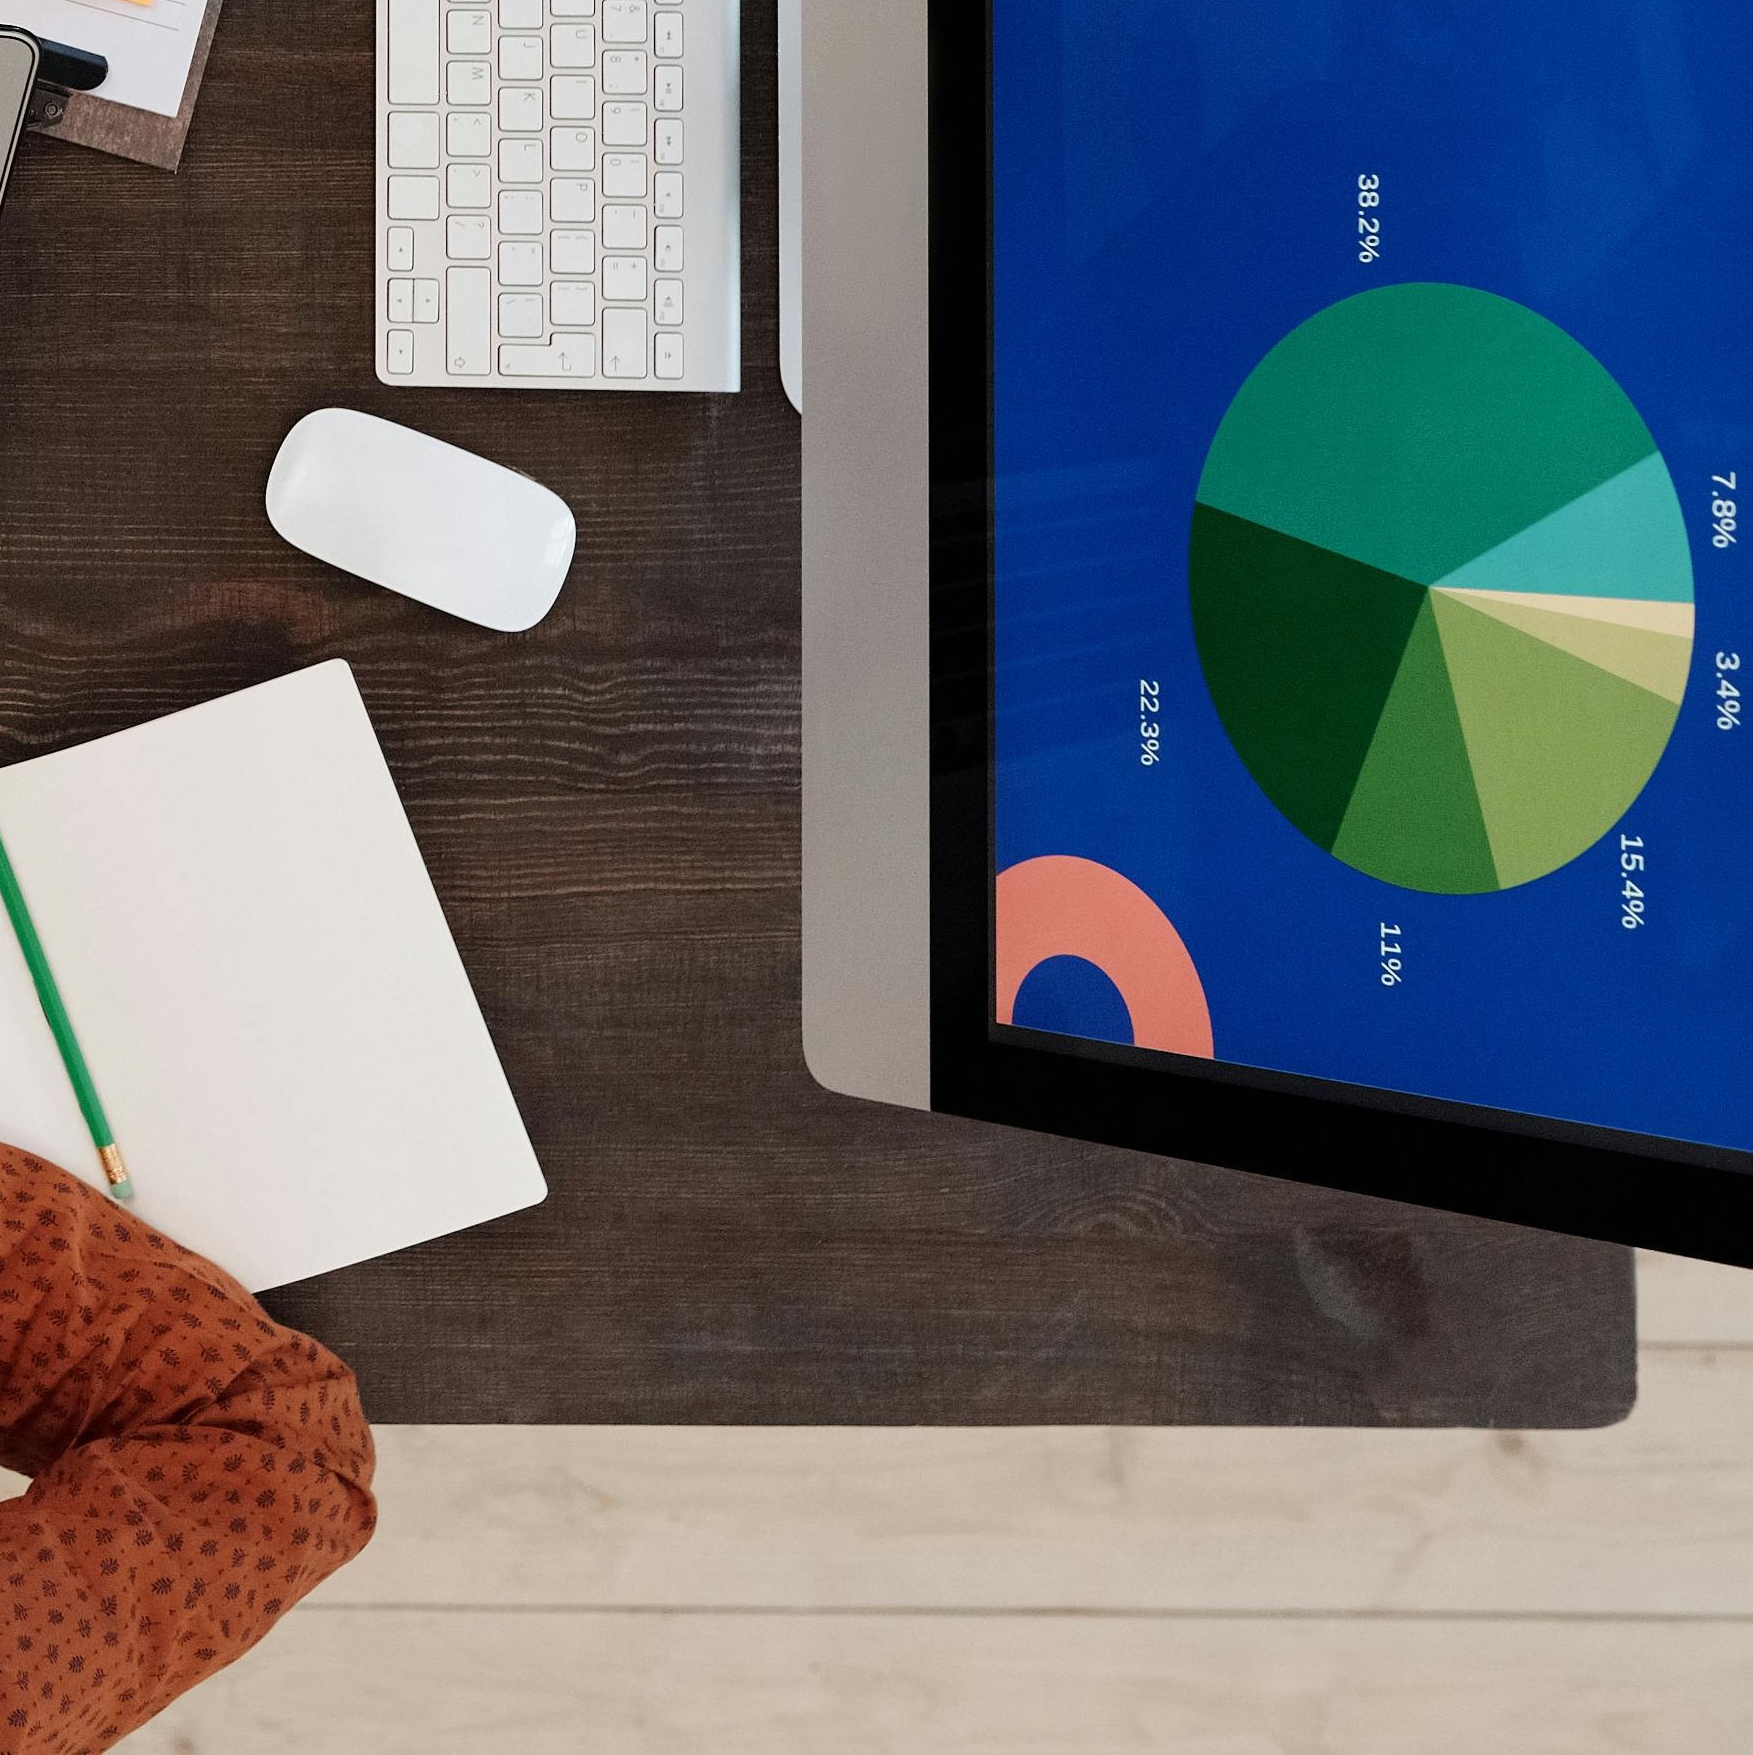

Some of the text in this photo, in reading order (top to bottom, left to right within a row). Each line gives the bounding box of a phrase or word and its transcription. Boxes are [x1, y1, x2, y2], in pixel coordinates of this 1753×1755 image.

[1358, 174, 1379, 262] 38.2%
[1712, 472, 1736, 548] 7.8%
[1141, 680, 1159, 765] 22.3%
[1716, 652, 1740, 730] 3.4%
[1621, 834, 1644, 929] 15.4%
[1381, 923, 1401, 986] 11%
